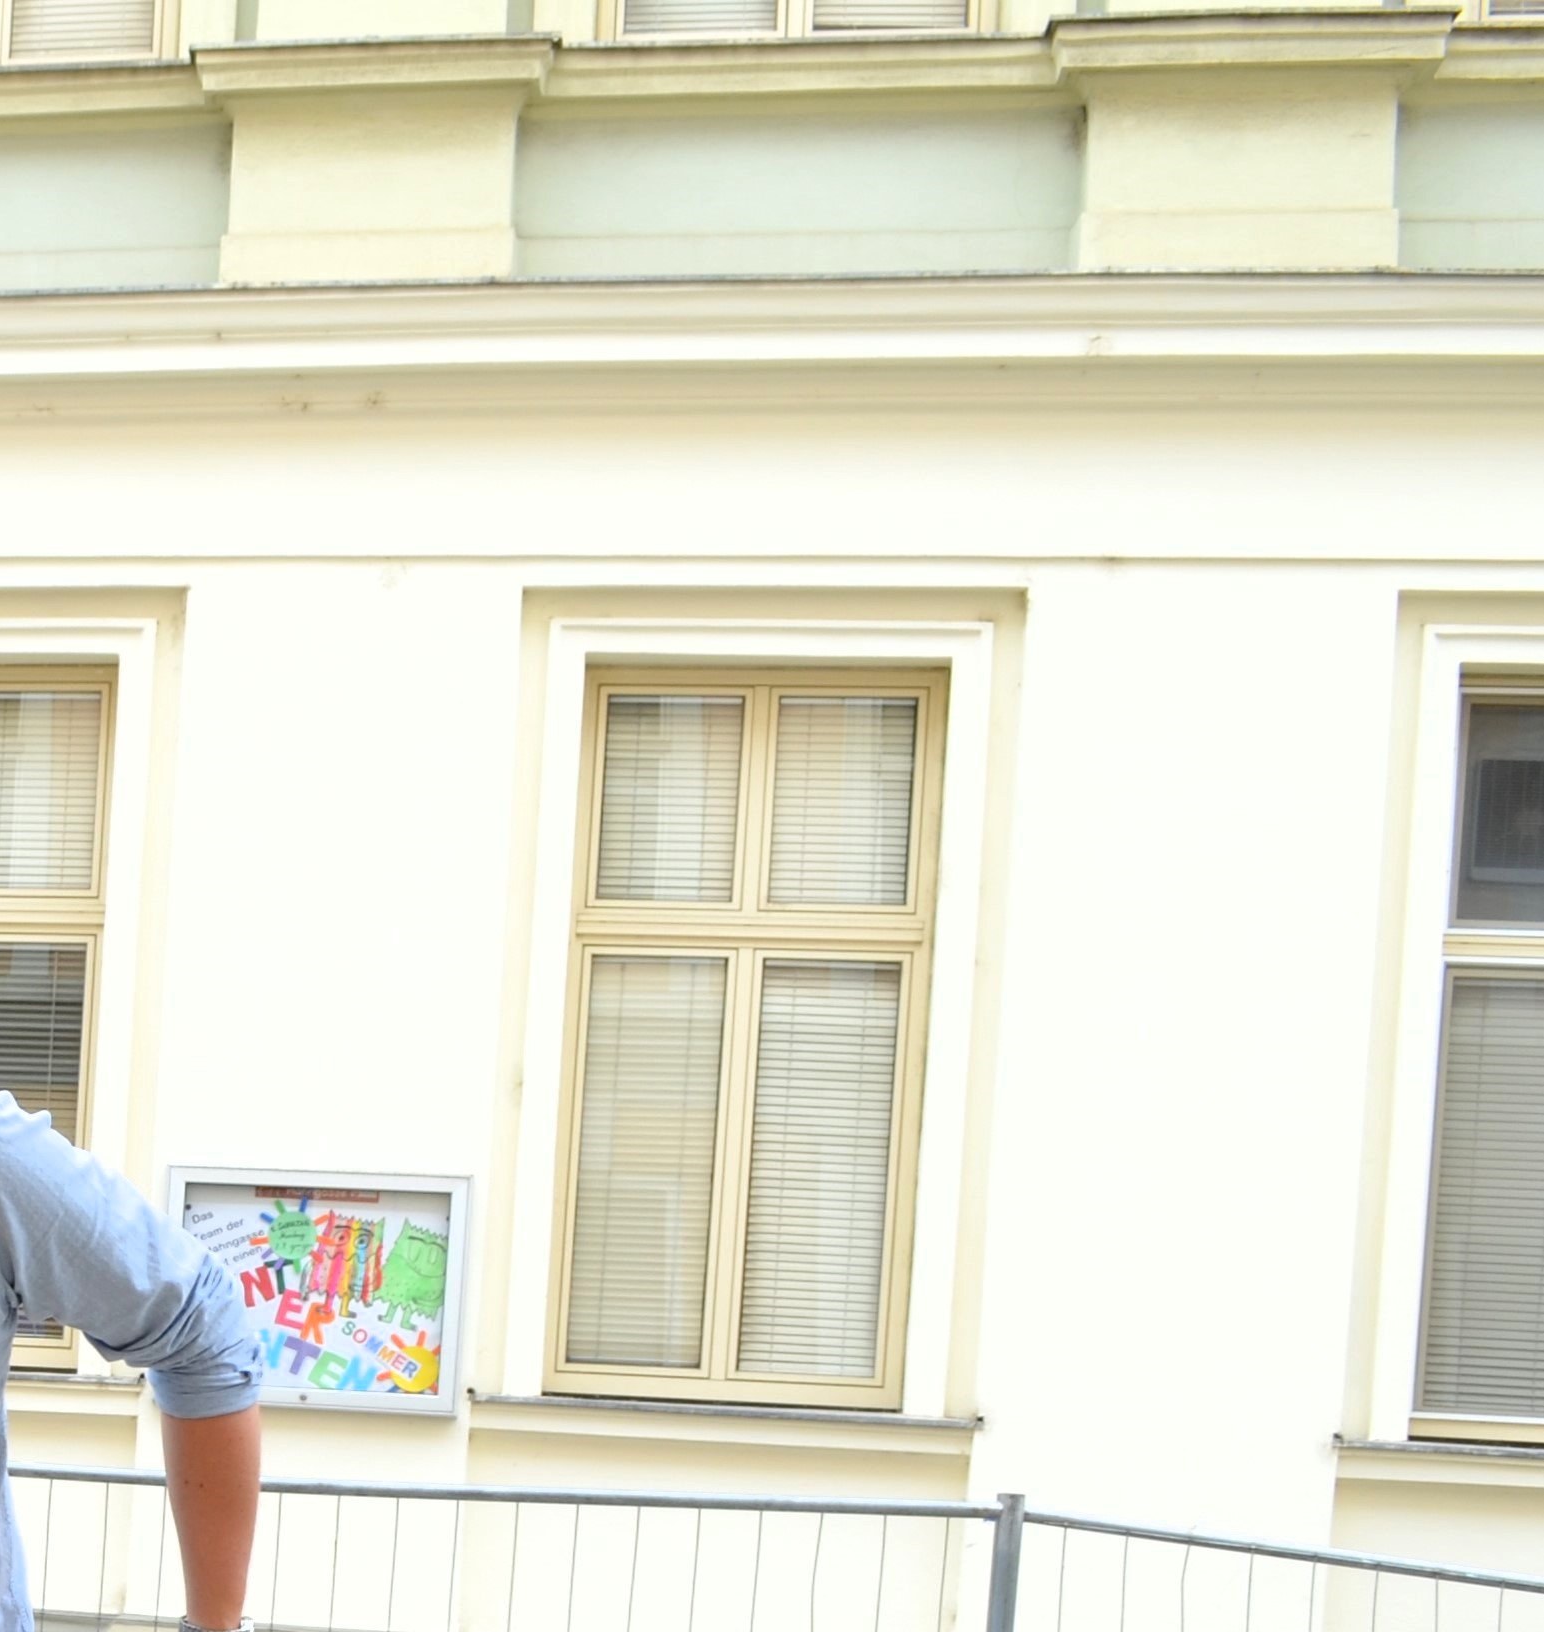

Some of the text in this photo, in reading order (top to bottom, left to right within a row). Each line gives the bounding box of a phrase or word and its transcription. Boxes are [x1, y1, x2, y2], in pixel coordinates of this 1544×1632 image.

[192, 1212, 213, 1224] Das
[194, 1219, 243, 1240] eam der
[208, 1230, 265, 1252] ahngasse
[233, 1246, 262, 1262] einen
[342, 1321, 418, 1378] SOMMER
